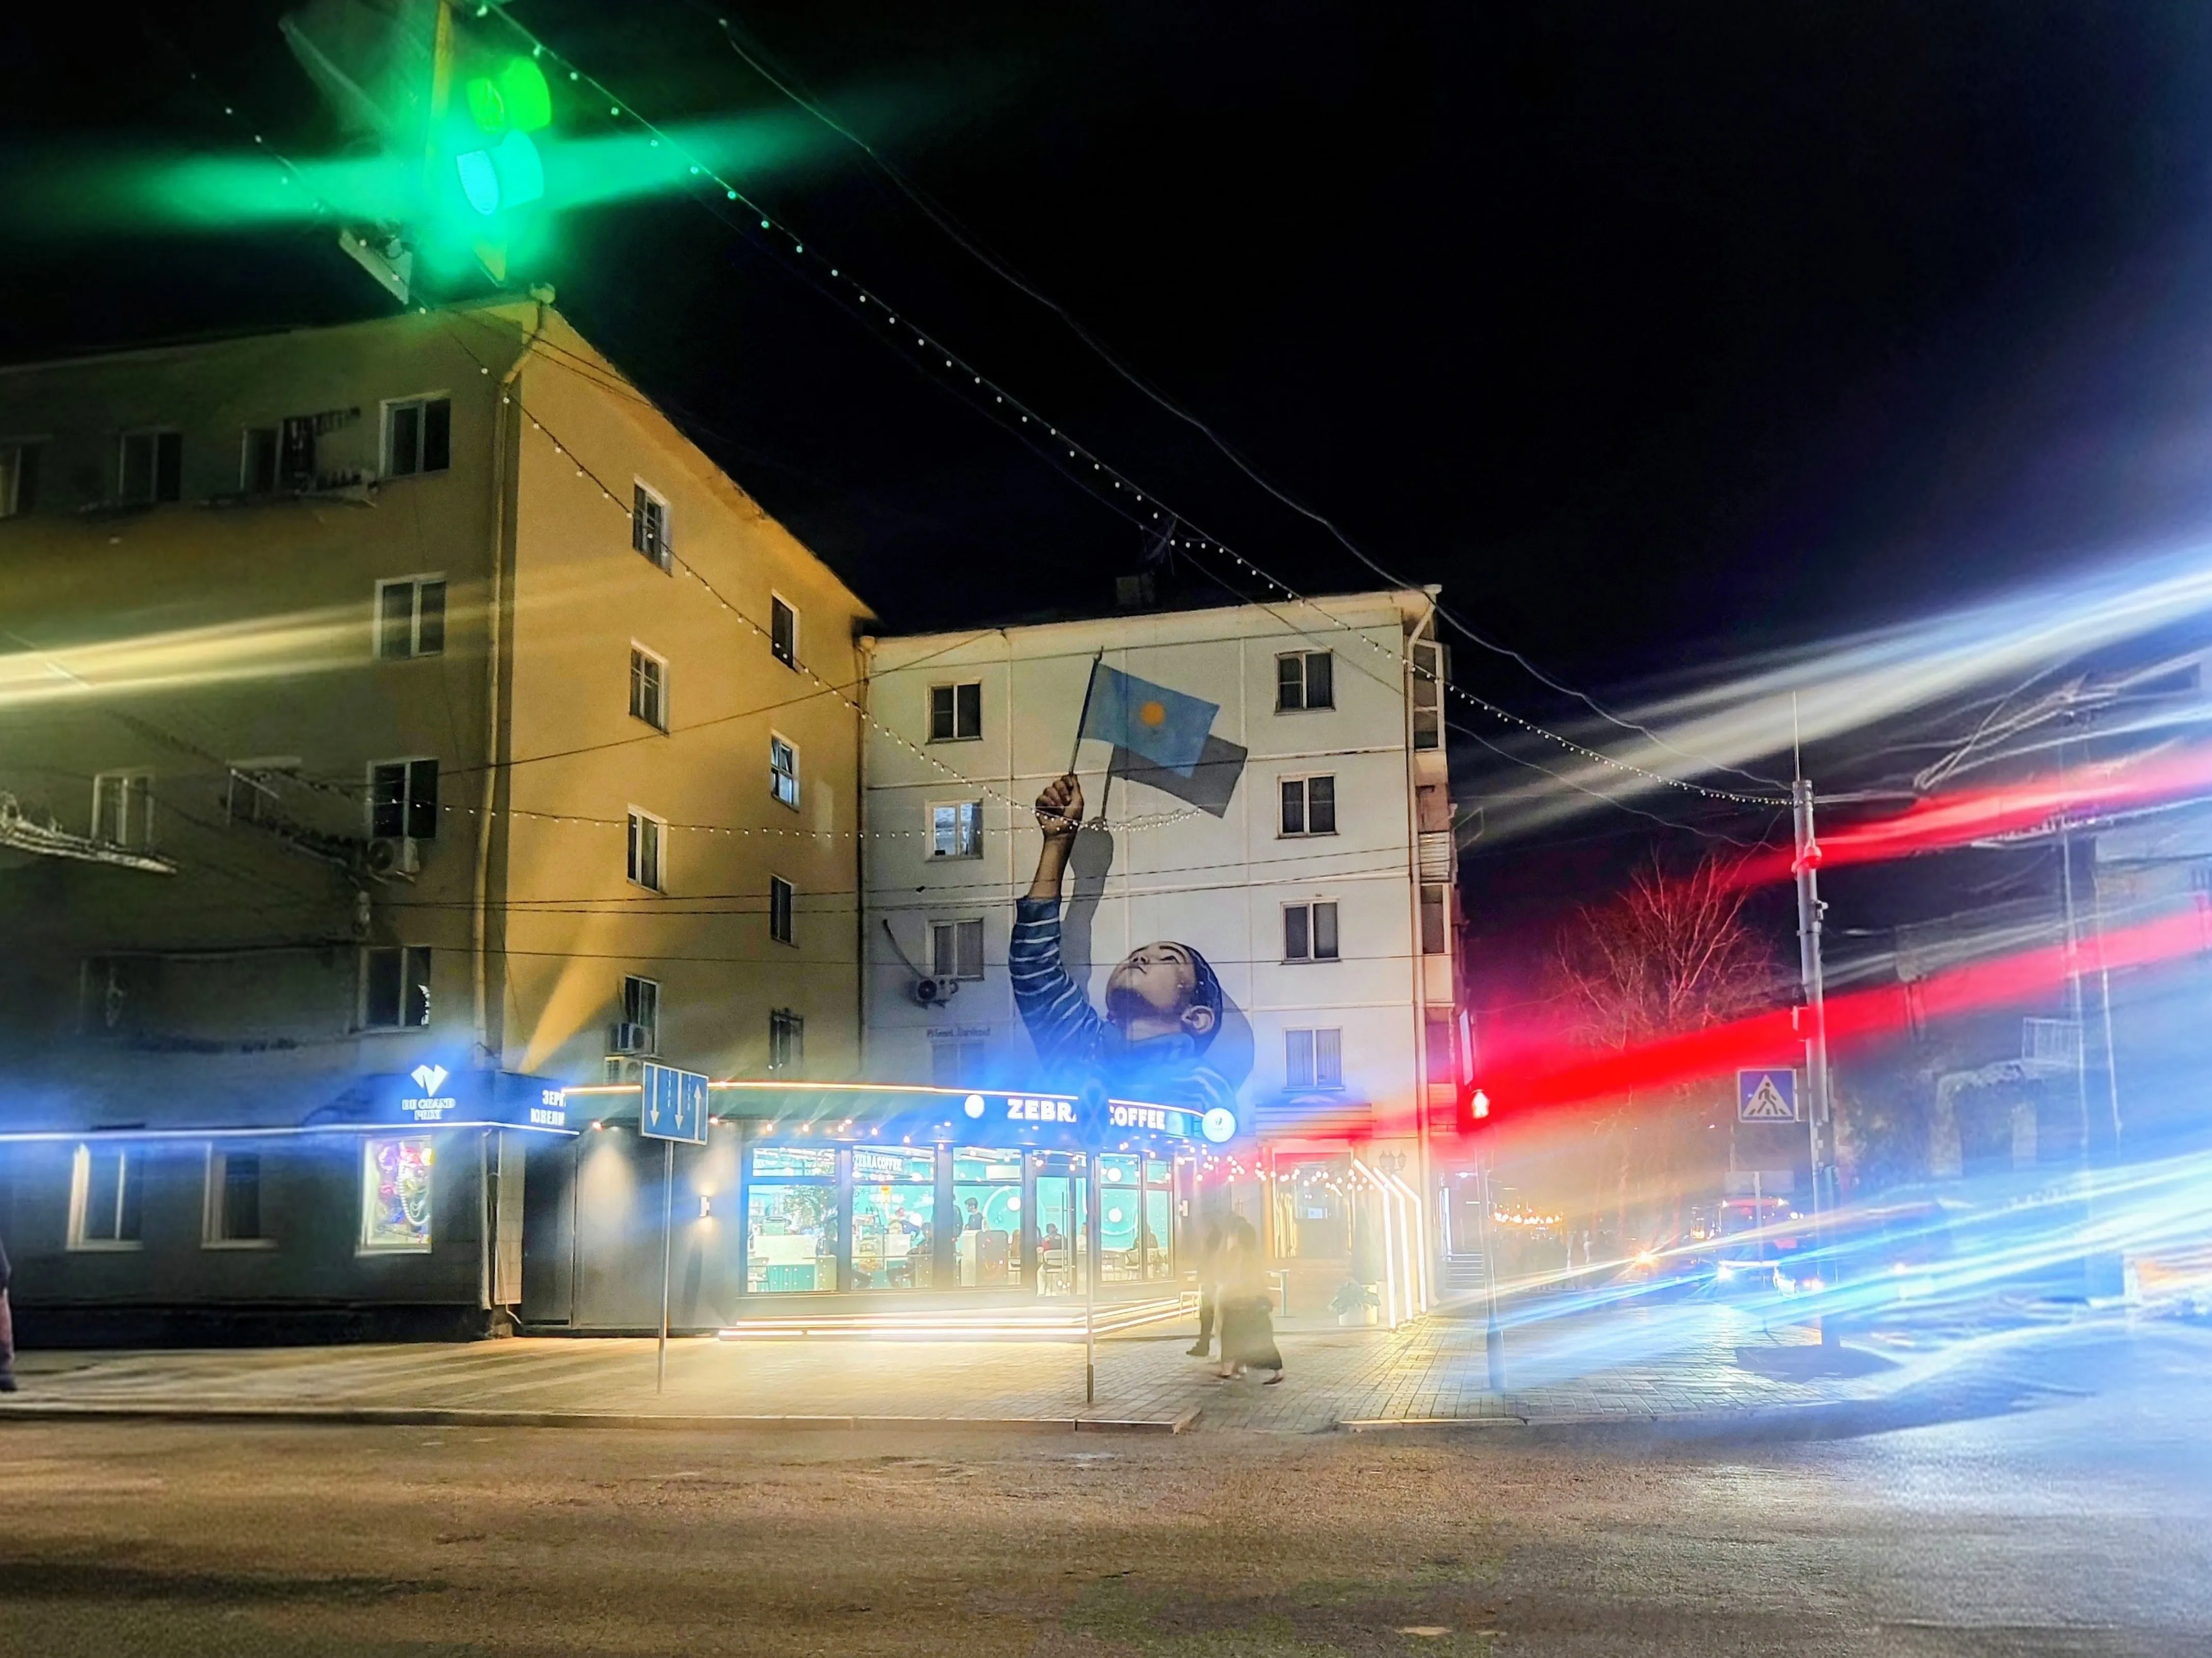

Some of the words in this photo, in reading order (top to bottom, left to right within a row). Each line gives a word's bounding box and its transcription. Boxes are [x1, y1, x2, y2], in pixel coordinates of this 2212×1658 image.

[417, 1097, 456, 1110] GRAND
[1007, 1098, 1077, 1122] ZEBR
[877, 1156, 903, 1172] COFFEE
